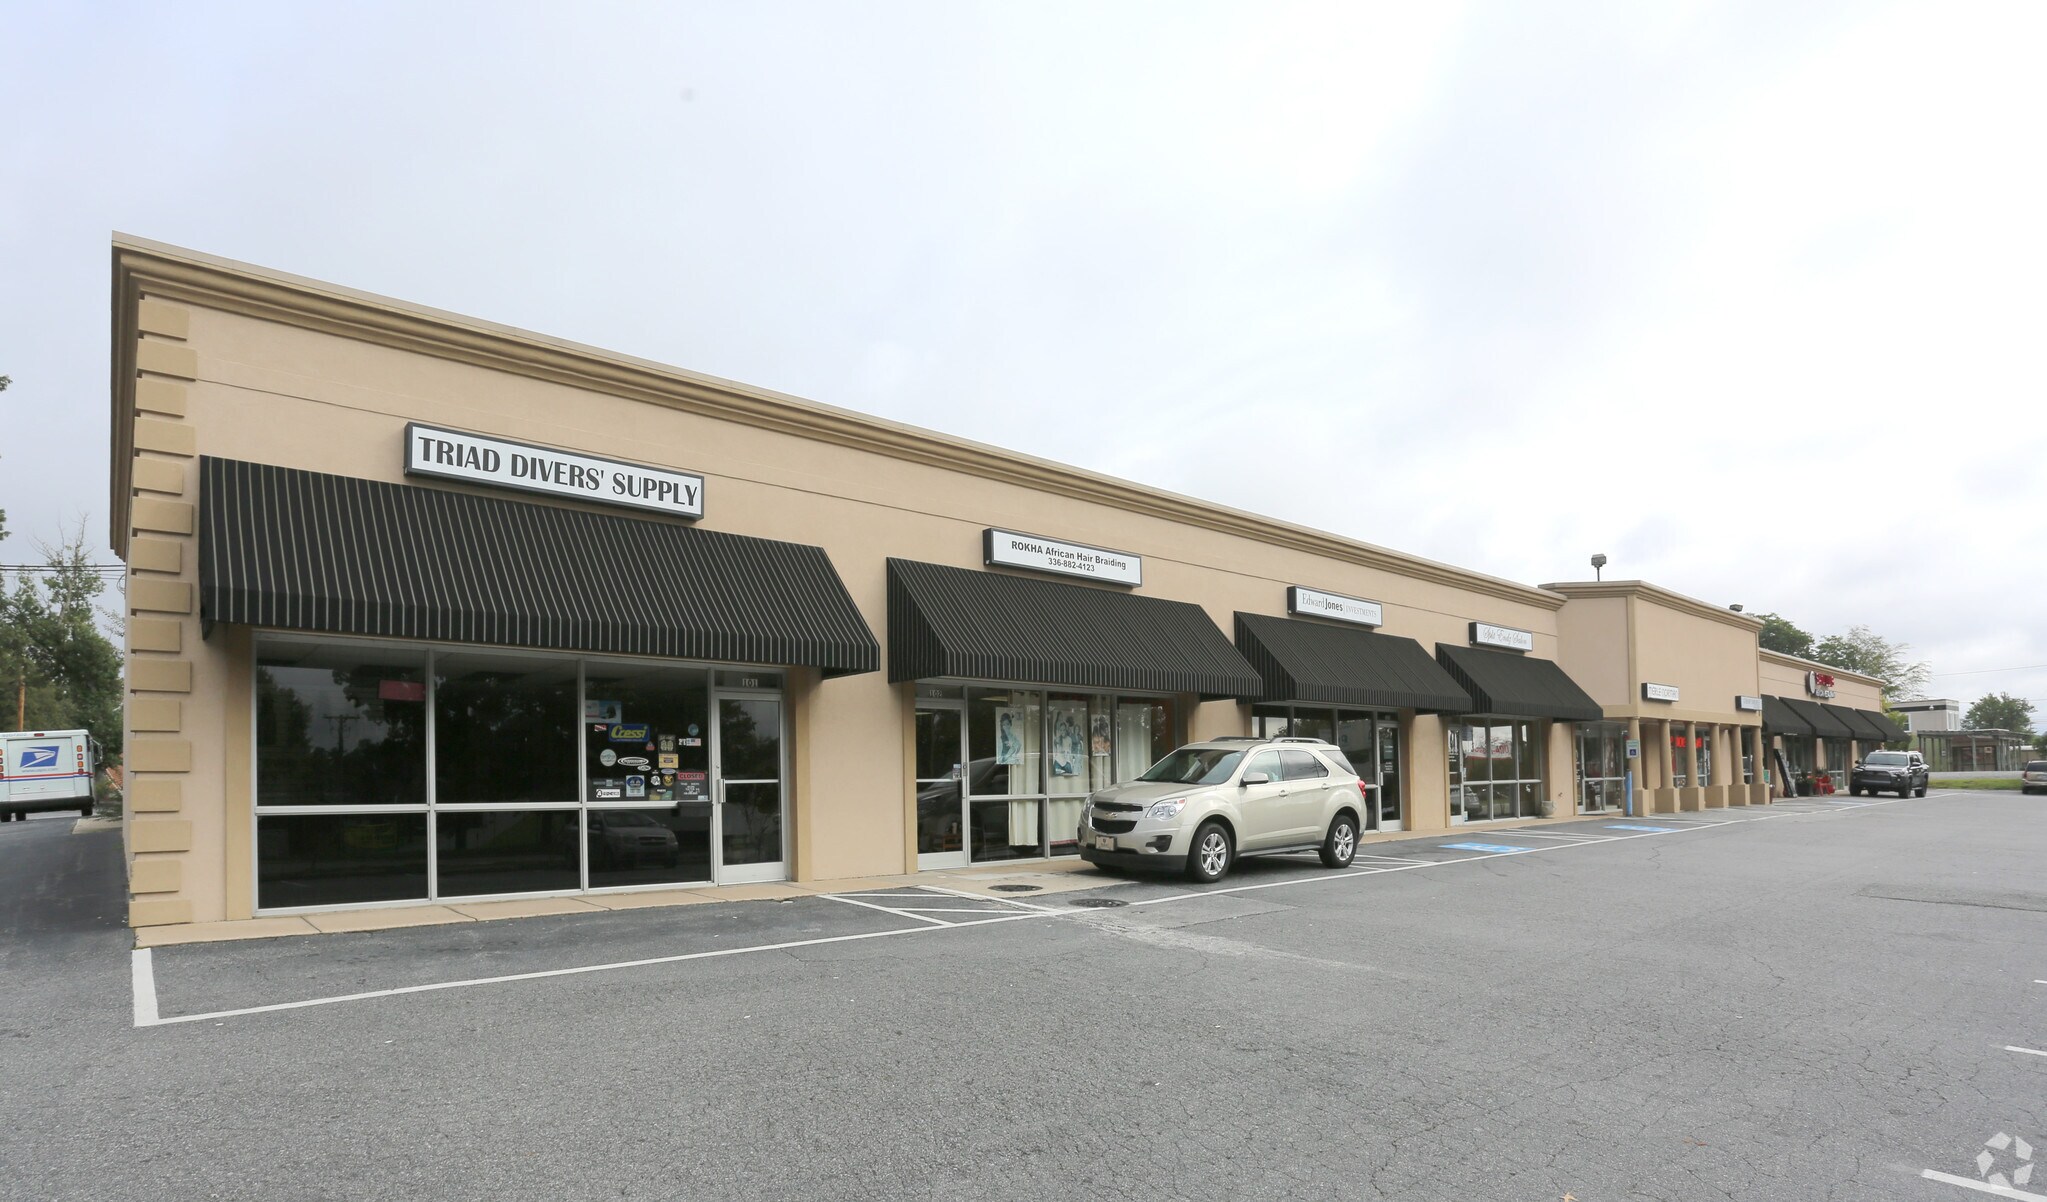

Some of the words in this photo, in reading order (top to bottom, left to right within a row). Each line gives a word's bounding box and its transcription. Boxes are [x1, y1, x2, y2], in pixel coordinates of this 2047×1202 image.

[418, 436, 501, 473] TRIAD
[511, 453, 605, 491] DIVERS'
[612, 472, 698, 507] SUPPLY
[1011, 540, 1043, 554] ROKHA
[1045, 547, 1075, 560] African
[1077, 552, 1094, 563] Hair
[1095, 556, 1126, 570] Braiding
[1048, 557, 1095, 572] 336-882-4123
[1325, 598, 1343, 611] Jones
[1346, 605, 1377, 618] INVESTMENTS
[742, 678, 758, 688] 101
[611, 725, 648, 738] Cressi
